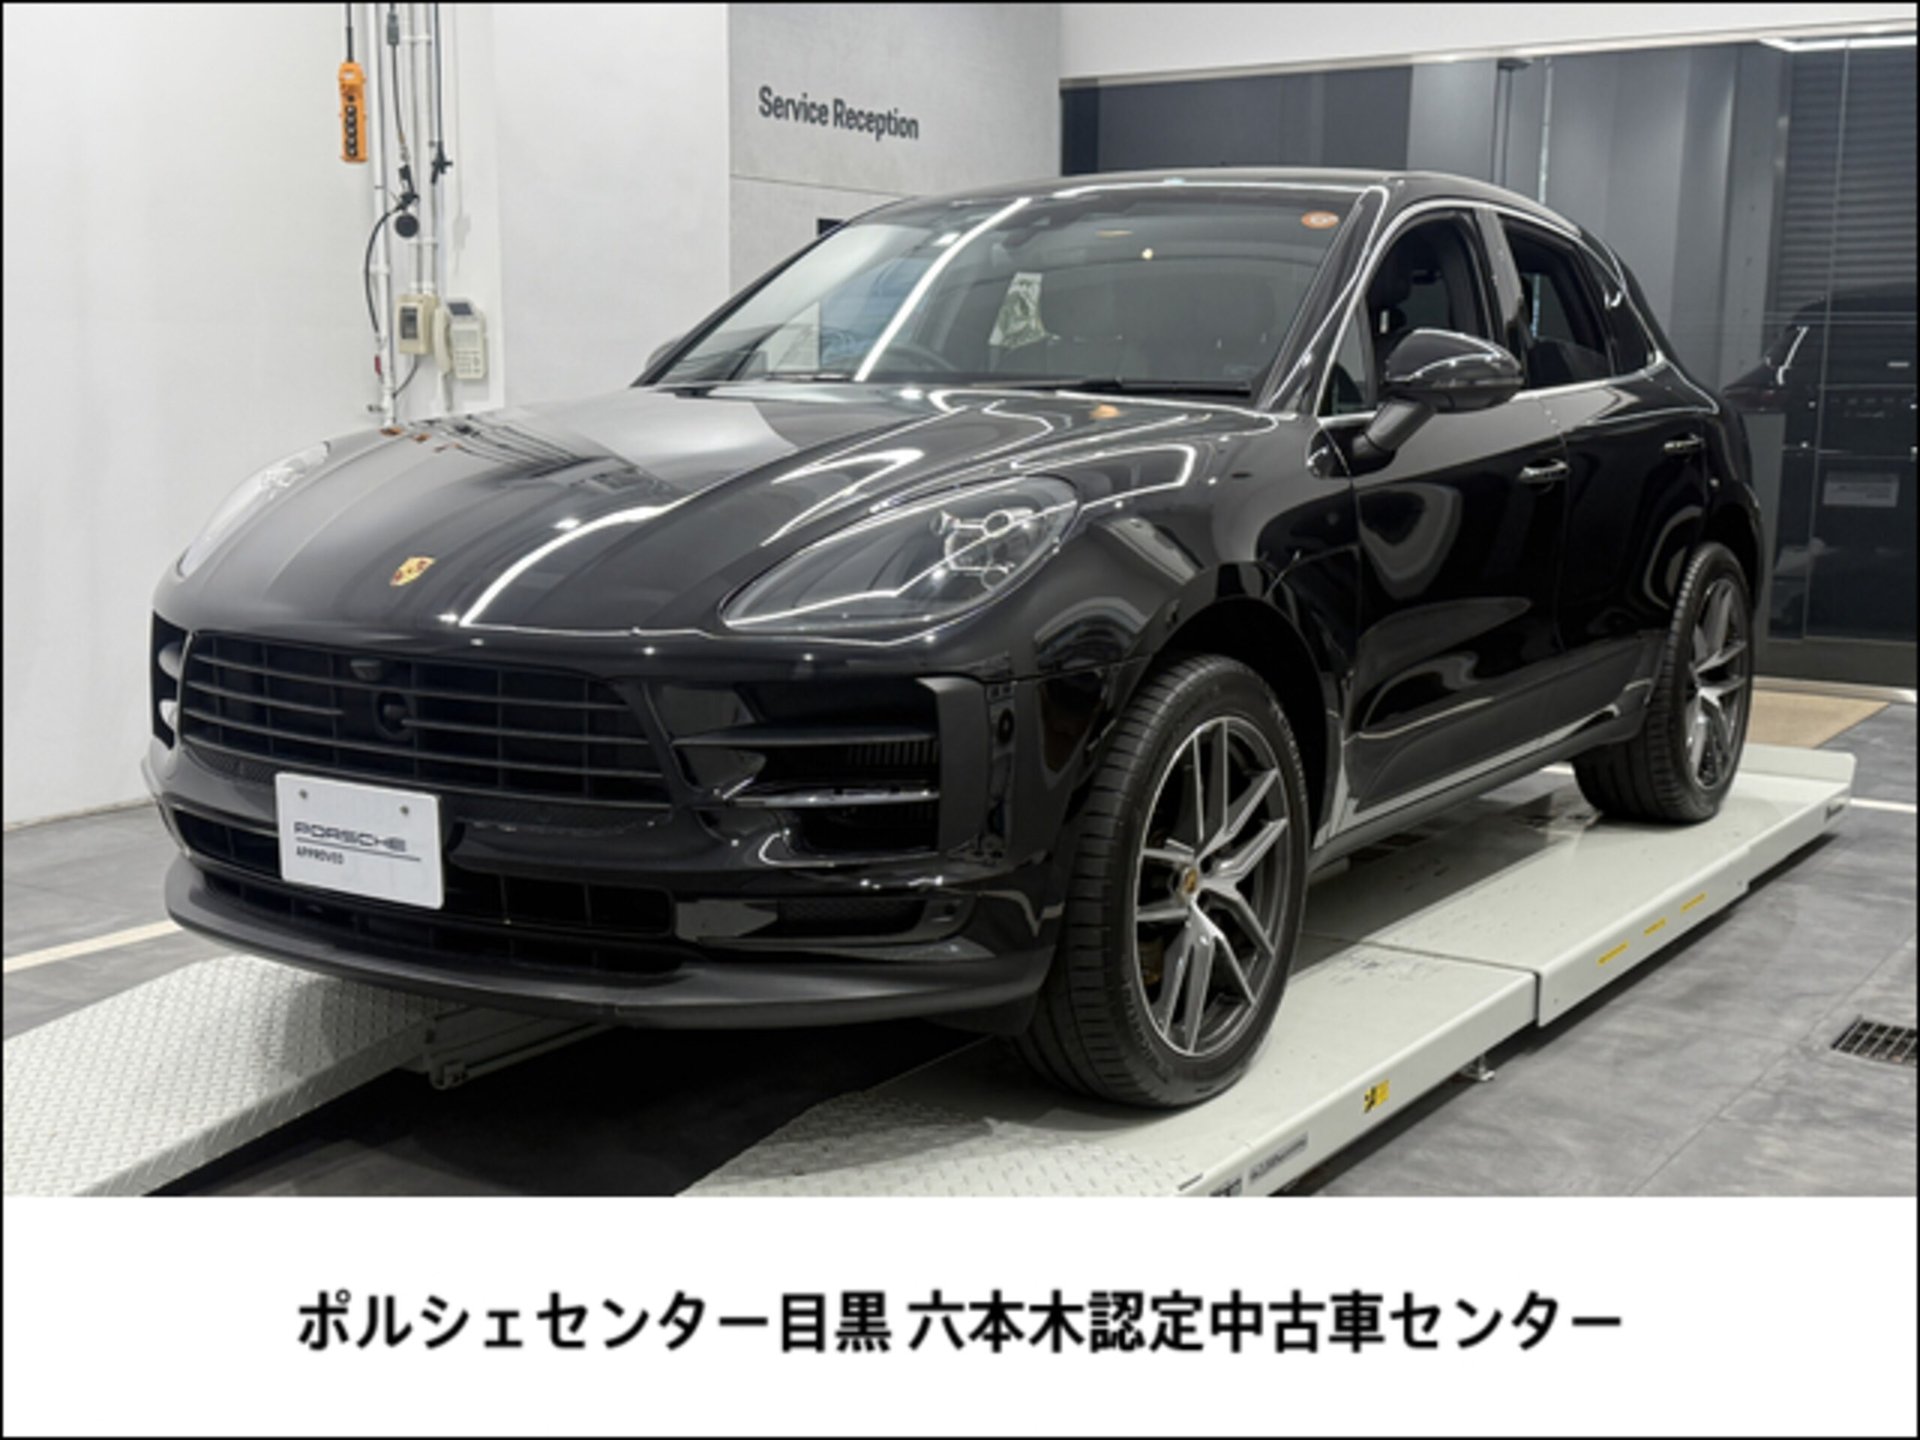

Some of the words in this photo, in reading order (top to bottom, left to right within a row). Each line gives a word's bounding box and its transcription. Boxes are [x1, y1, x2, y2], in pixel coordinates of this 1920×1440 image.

[758, 84, 829, 126] Service
[833, 98, 919, 142] Reception
[293, 821, 407, 853] PORSCHE
[296, 846, 345, 865] APPROVED
